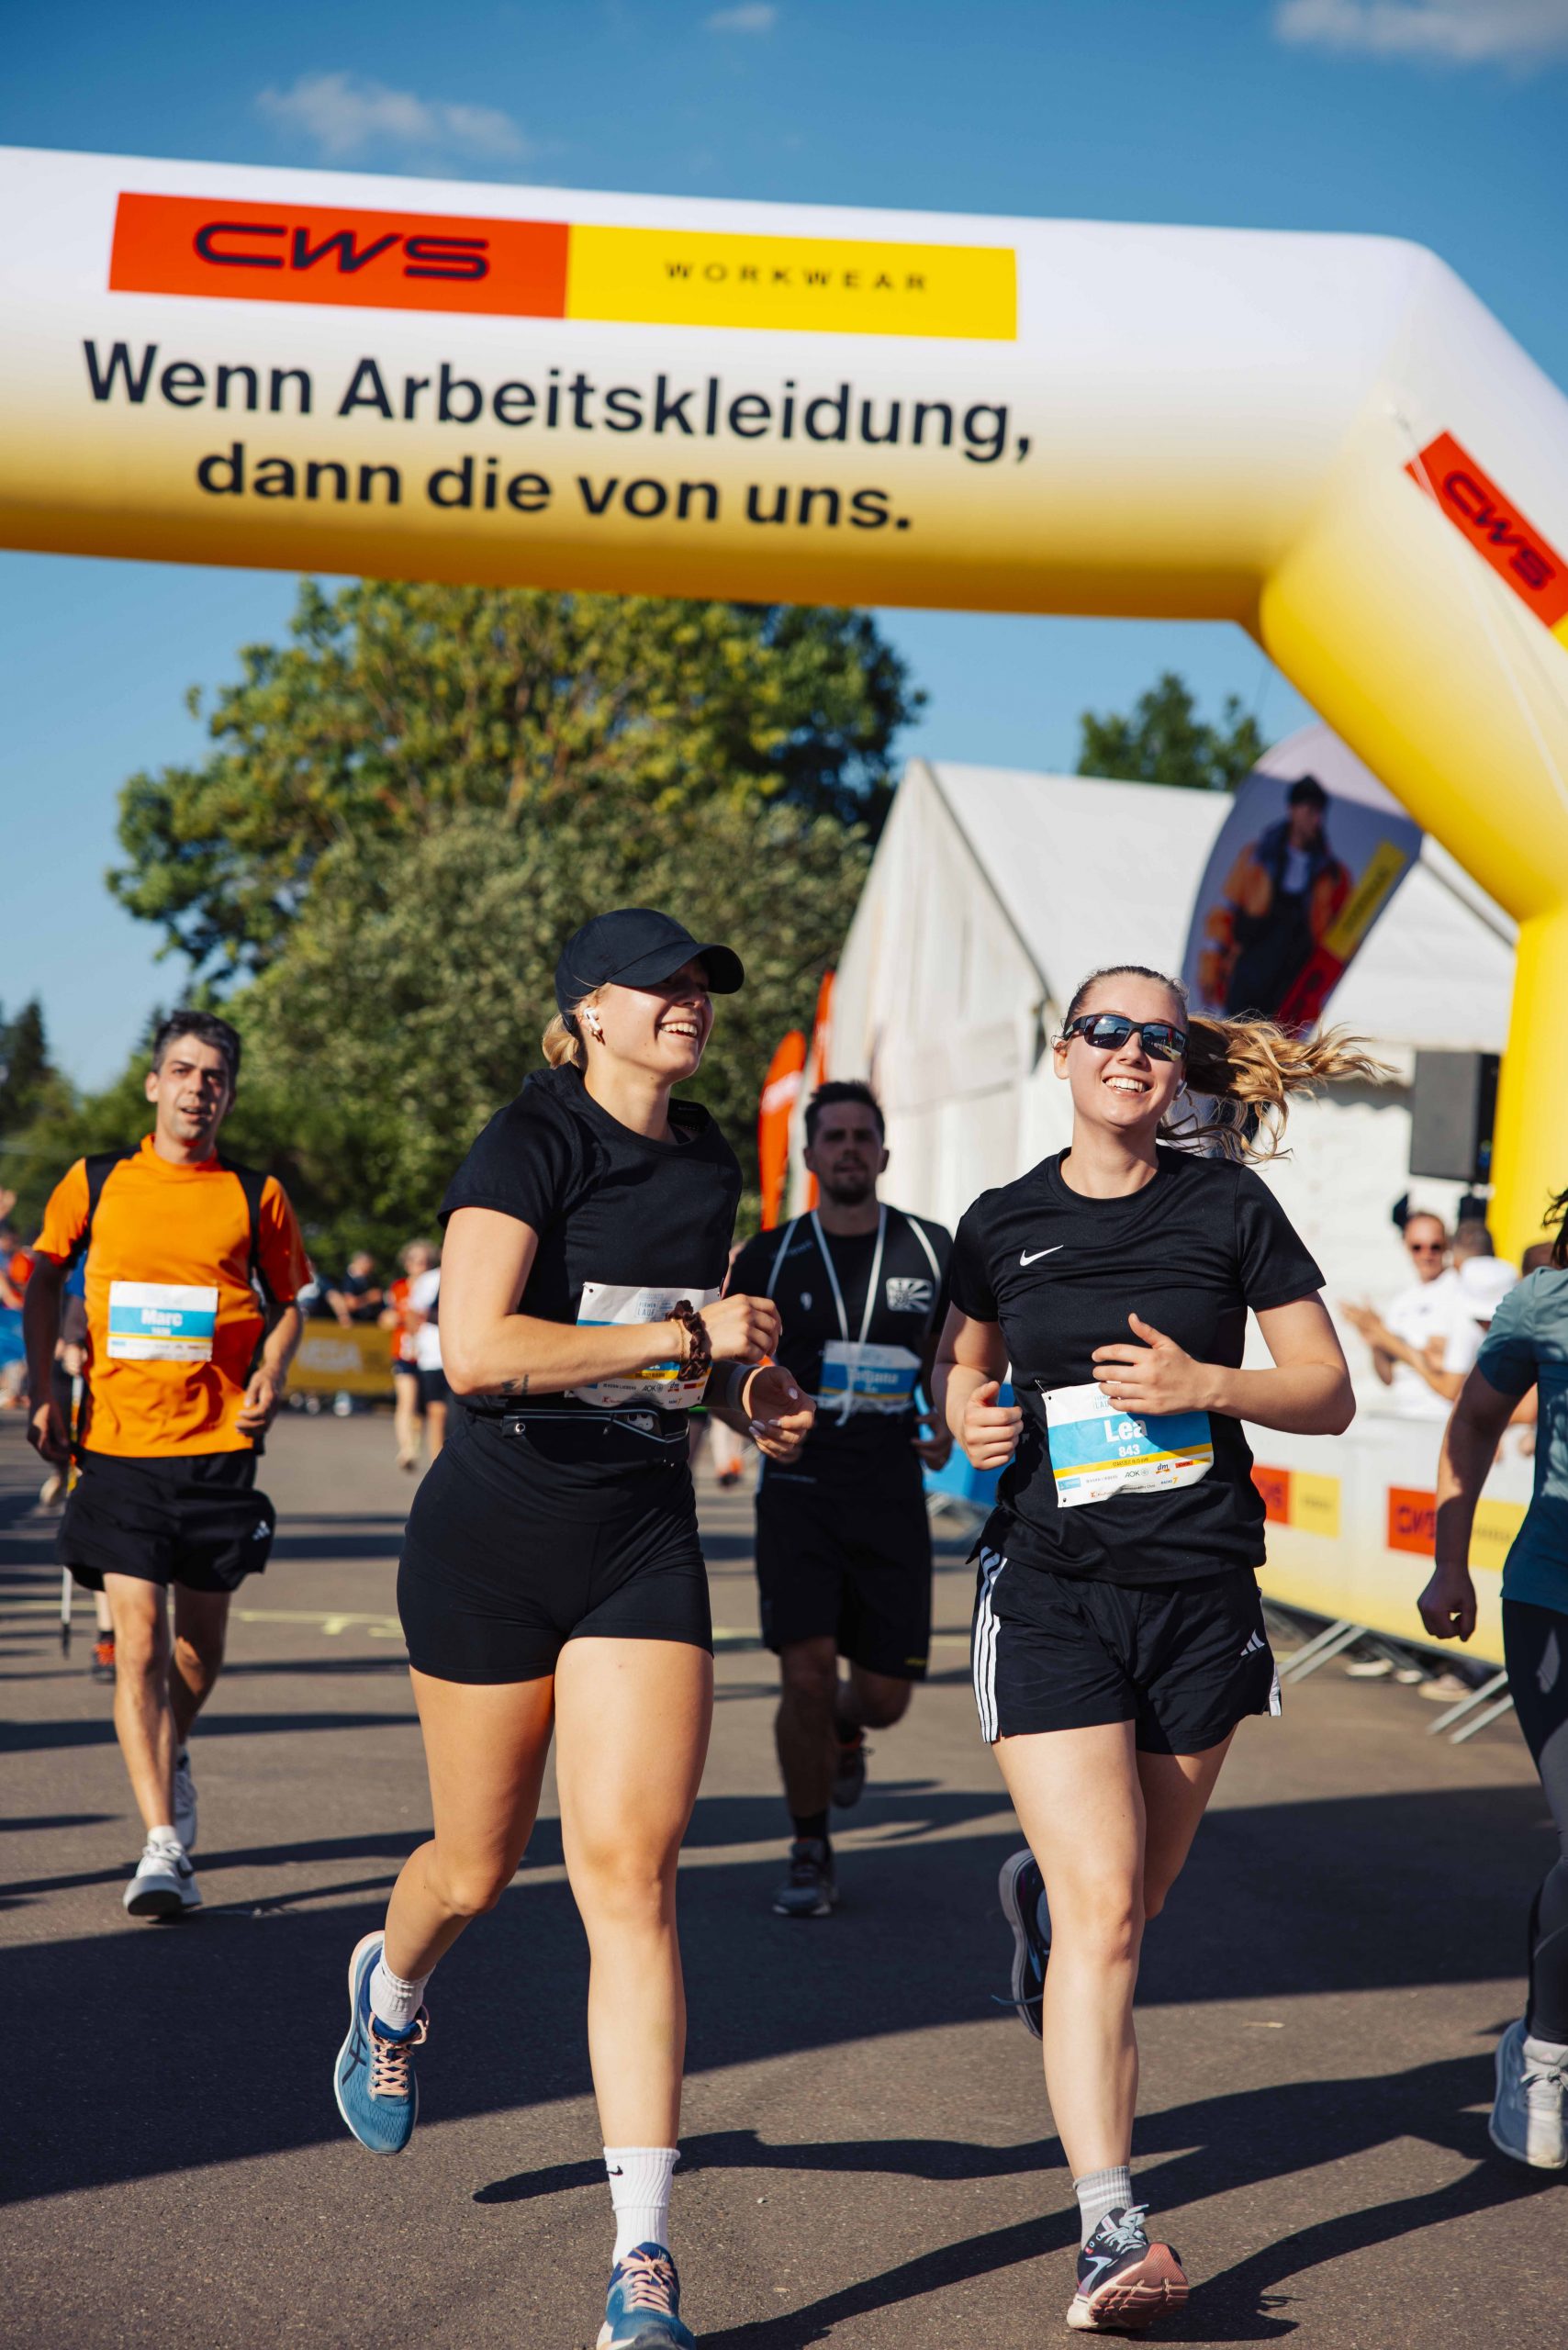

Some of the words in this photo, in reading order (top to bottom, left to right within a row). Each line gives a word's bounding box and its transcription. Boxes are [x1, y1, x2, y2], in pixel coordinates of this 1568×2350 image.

[194, 222, 491, 280] CWS
[664, 262, 927, 292] WORKWEAR
[83, 339, 313, 415] Wenn
[337, 357, 1032, 464] Arbeitskleidung,
[196, 442, 402, 506] dann
[426, 455, 553, 513] die
[577, 476, 720, 522] von
[745, 484, 912, 532] uns.
[1442, 470, 1556, 591] CWS
[140, 1308, 183, 1327] Marc
[1103, 1419, 1148, 1443] Lea
[1118, 1443, 1141, 1458] 843
[1125, 1471, 1140, 1479] AOK
[1157, 1462, 1169, 1471] dm
